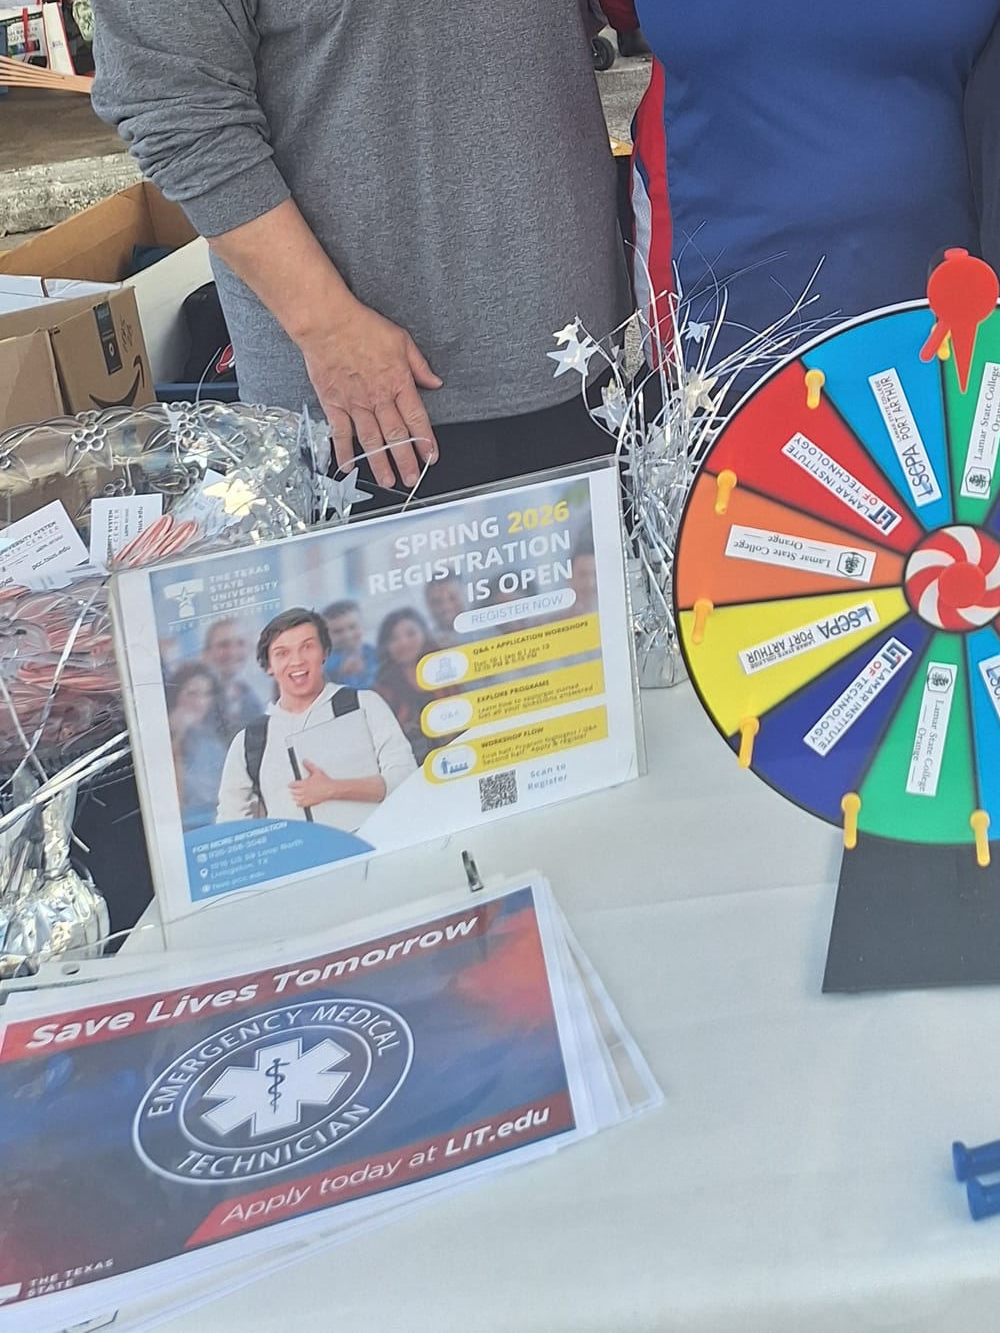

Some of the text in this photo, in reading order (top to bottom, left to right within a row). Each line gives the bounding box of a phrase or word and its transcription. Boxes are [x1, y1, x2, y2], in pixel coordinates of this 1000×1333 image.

[881, 376, 912, 440] PORT ARTHUR
[974, 366, 1000, 460] Lamar State College
[786, 444, 836, 487] INSTITUTE
[794, 437, 878, 505] OF TECHNOLOGY
[902, 443, 934, 498] LSCPA
[835, 487, 870, 514] LAMAR
[394, 500, 570, 559] SPRING 2026
[768, 535, 803, 550] Orange
[367, 529, 572, 596] REGISTRATION
[734, 541, 831, 568] Lamar State College
[210, 579, 244, 593] STATE
[211, 580, 279, 602] UNIVERSITY
[467, 558, 573, 603] IS OPEN
[471, 593, 565, 625] REGISTER NOW
[816, 606, 873, 639] LSCPA
[497, 632, 543, 649] APPLICATION
[746, 629, 814, 663] PORT ARTHUR
[810, 661, 882, 743] OF TECHNOLOGY
[860, 668, 892, 702] LAMAR
[819, 703, 863, 750] INSTITUTE
[912, 728, 927, 761] Orange
[919, 699, 944, 792] Lamar State College
[527, 774, 568, 790] Register
[530, 766, 553, 778] Scan
[25, 914, 480, 1051] Save Lives Tomorrow
[147, 1005, 400, 1118] EMERGENCY MEDICAL
[177, 1104, 370, 1175] TECHNICIAN
[220, 1106, 550, 1226] Apply today at LIT.edu
[28, 1279, 74, 1297] STATE
[30, 1258, 114, 1286] THE TEXAS
